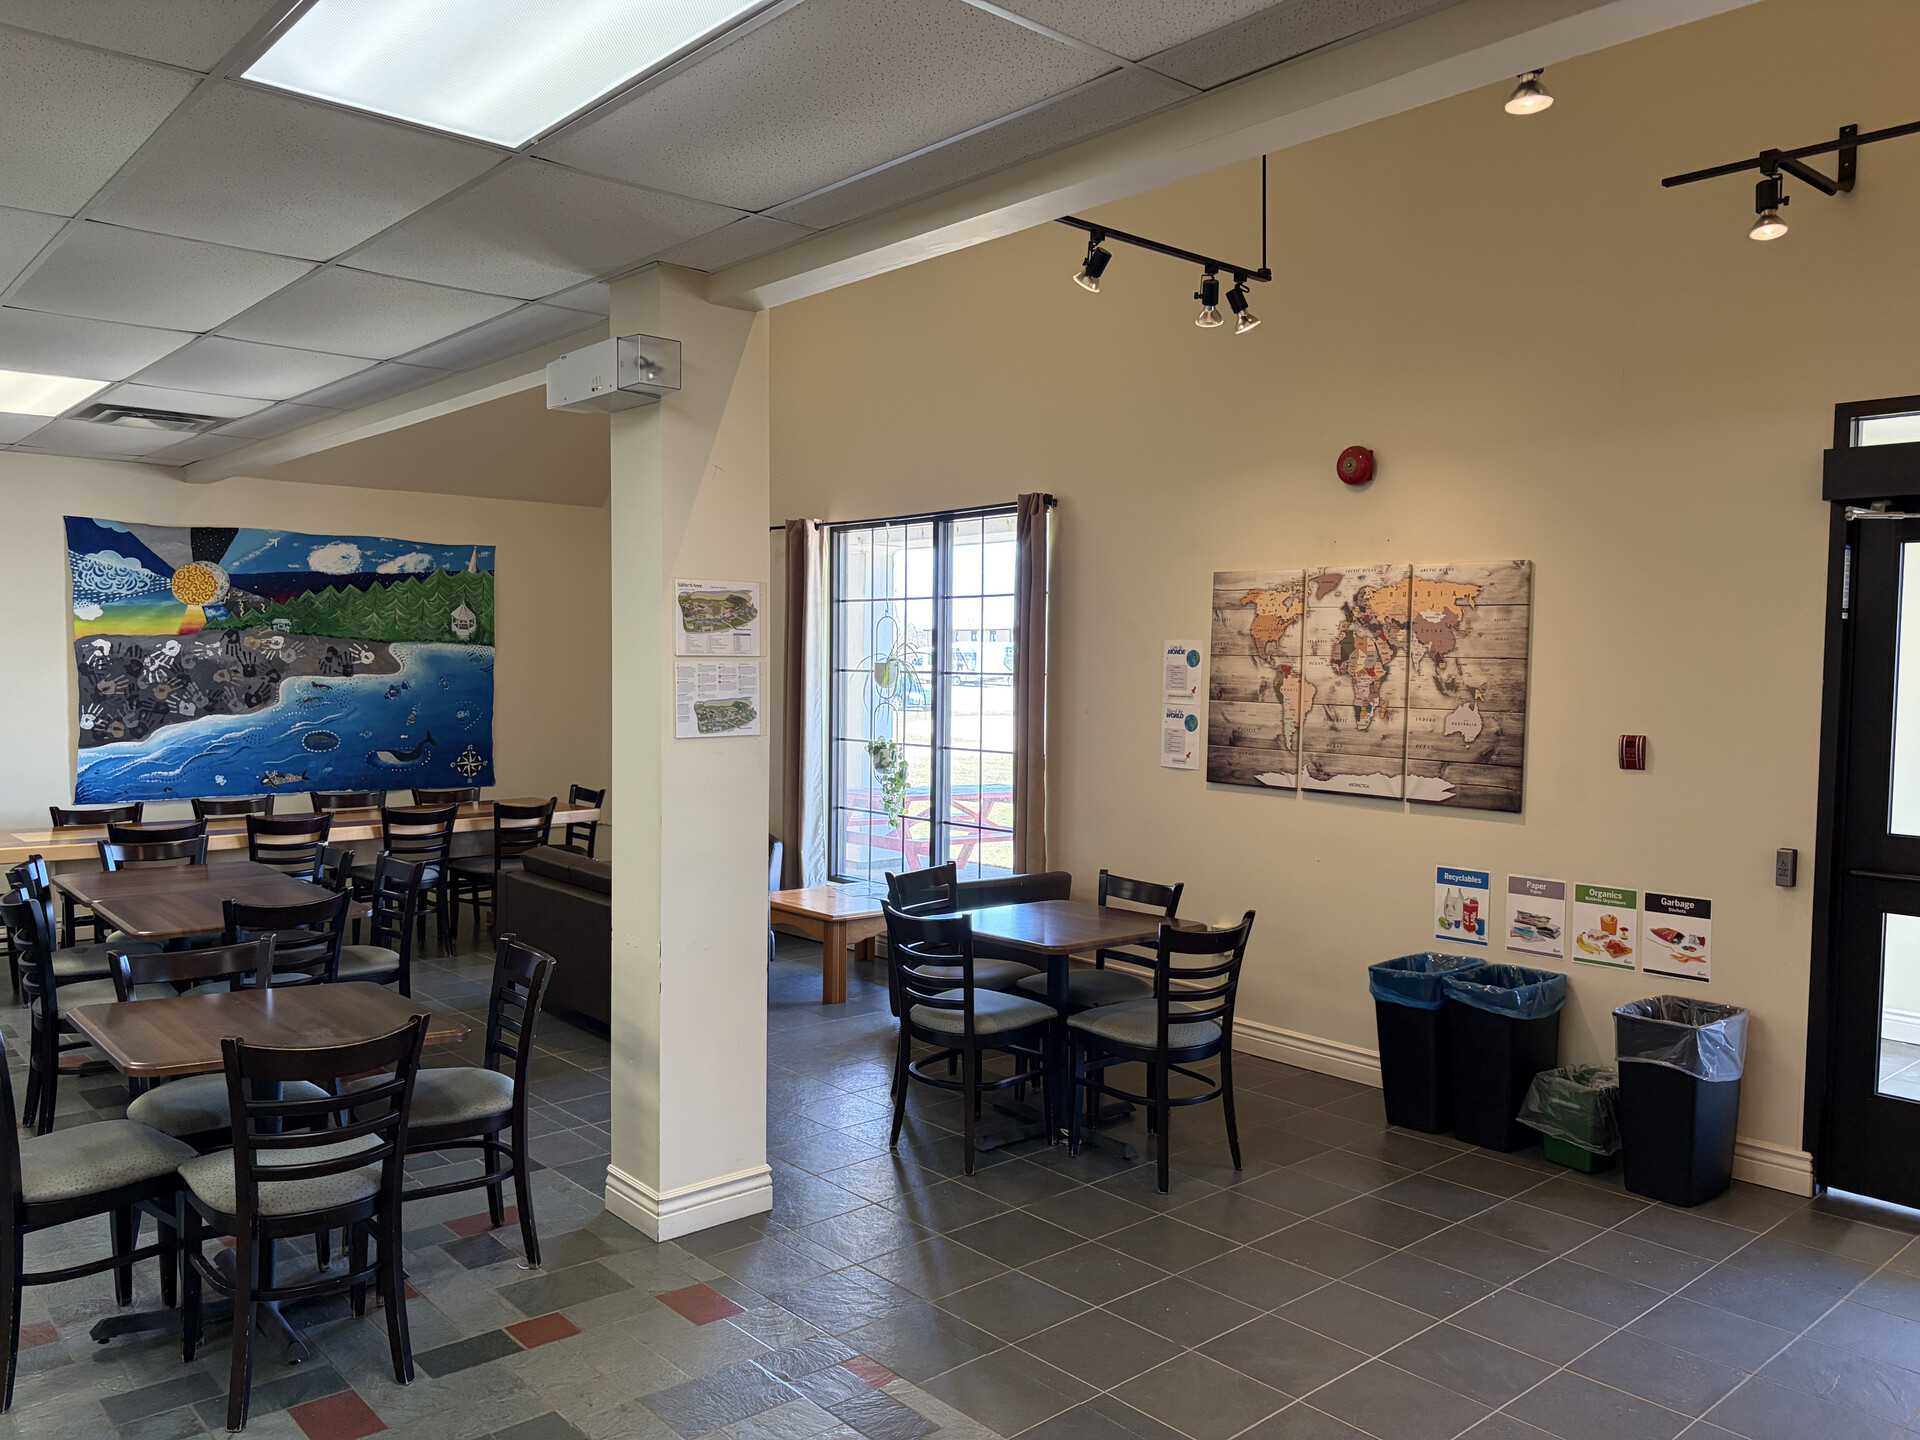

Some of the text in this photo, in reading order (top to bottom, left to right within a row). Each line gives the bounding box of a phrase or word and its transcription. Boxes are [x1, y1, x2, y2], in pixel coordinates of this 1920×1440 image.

[1389, 590, 1457, 598] RUSSIA
[1444, 872, 1482, 884] Recyclables
[1526, 880, 1547, 891] Paper
[1588, 888, 1623, 900] Organics
[1660, 897, 1695, 910] Garbage
